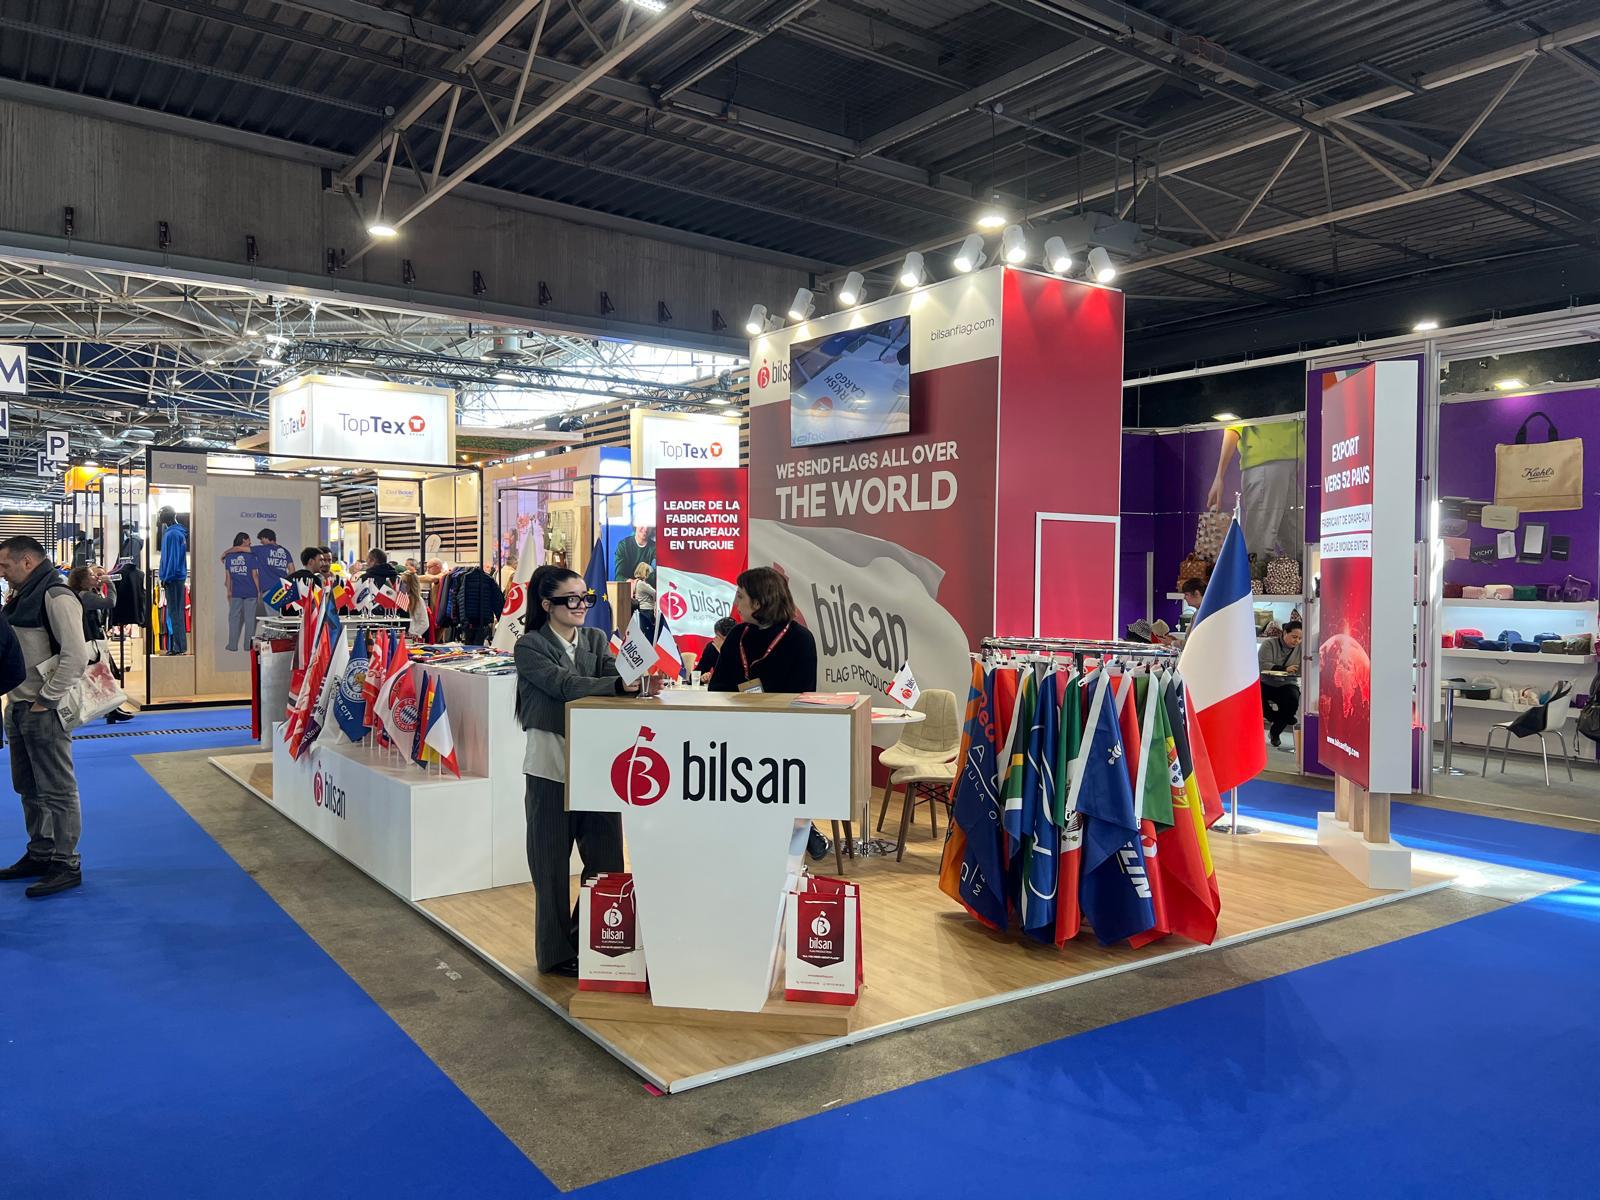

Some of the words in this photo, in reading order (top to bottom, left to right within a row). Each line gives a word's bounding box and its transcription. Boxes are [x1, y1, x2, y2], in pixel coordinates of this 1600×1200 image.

[931, 318, 995, 341] bilsanflag.com
[0, 354, 26, 384] M
[835, 372, 867, 399] CARGO
[338, 412, 406, 436] TopTex
[51, 436, 65, 456] P
[660, 440, 708, 460] TopTex
[1331, 435, 1360, 463] EXPORT
[40, 453, 54, 472] R
[776, 462, 795, 480] WE
[797, 458, 831, 477] SEND
[833, 451, 878, 473] FLAGS
[880, 447, 910, 468] ALL
[912, 440, 960, 465] OVER
[1324, 472, 1341, 493] VERS
[1341, 469, 1351, 491] 52
[1351, 465, 1370, 487] PAYS
[1521, 467, 1555, 480] Kiehl's
[663, 500, 706, 510] LEADER
[708, 500, 723, 510] DE
[725, 500, 740, 510] LA
[776, 482, 827, 520] THE
[831, 470, 958, 516] WORLD
[666, 514, 738, 523] FABRICATION
[663, 527, 678, 537] DE
[680, 527, 740, 537] DRAPEAUX
[269, 549, 287, 560] KIDS
[670, 540, 685, 550] EN
[687, 540, 735, 550] TURQUIE
[1474, 549, 1494, 557] VICHY
[229, 565, 248, 573] WEAR
[267, 557, 288, 568] WEAR
[688, 589, 731, 618] bilsan
[811, 583, 909, 673] bilsan
[623, 640, 644, 668] bilsan
[825, 666, 850, 683] FLAG
[851, 664, 889, 696] PRODUC
[340, 705, 354, 721] CITY
[682, 740, 806, 805] bilsan
[324, 772, 346, 821] bilsan
[601, 928, 624, 940] bilsan
[809, 937, 833, 951] bilsan
